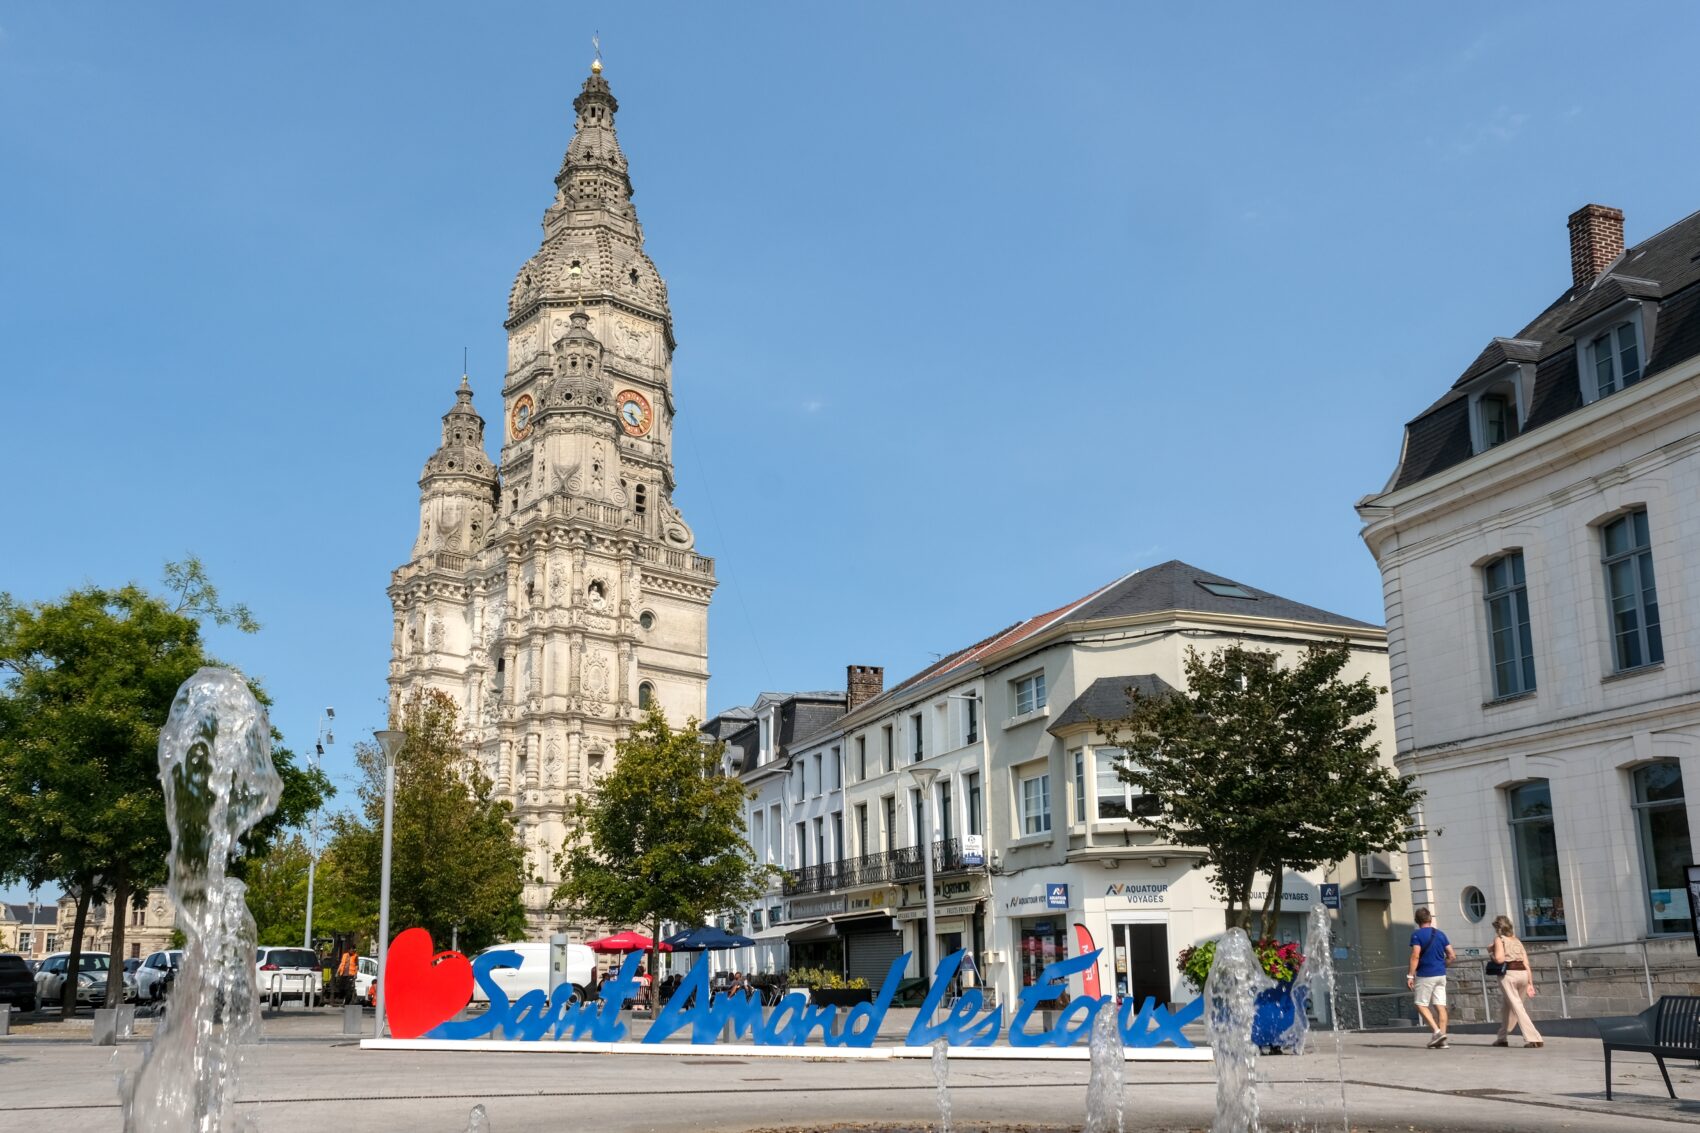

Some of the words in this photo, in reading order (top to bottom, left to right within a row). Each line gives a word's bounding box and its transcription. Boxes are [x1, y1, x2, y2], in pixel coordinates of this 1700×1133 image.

[1126, 885, 1168, 893] AQUATOUR
[424, 949, 645, 1042] Saint
[642, 948, 912, 1047] Amand
[1008, 947, 1204, 1049] Eaux
